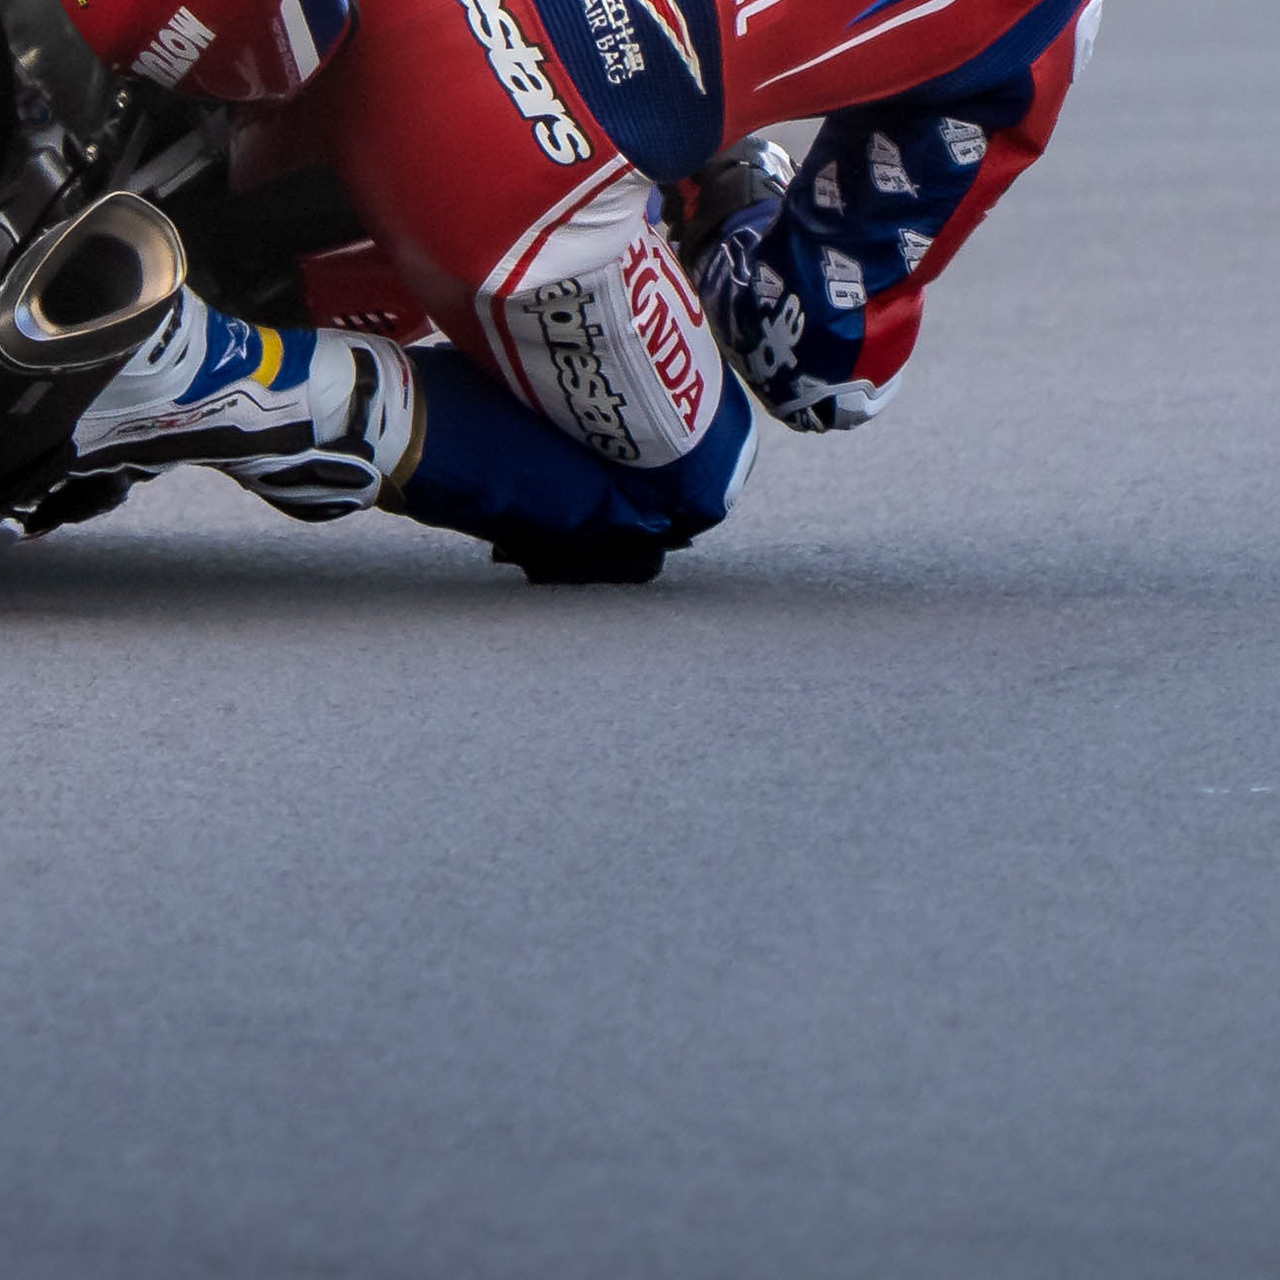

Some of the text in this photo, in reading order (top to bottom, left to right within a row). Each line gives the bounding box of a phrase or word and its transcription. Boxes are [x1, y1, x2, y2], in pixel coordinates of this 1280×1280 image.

[130, 5, 217, 90] MOTUL
[594, 33, 628, 86] BAG
[939, 116, 989, 166] 46
[821, 245, 868, 310] 46
